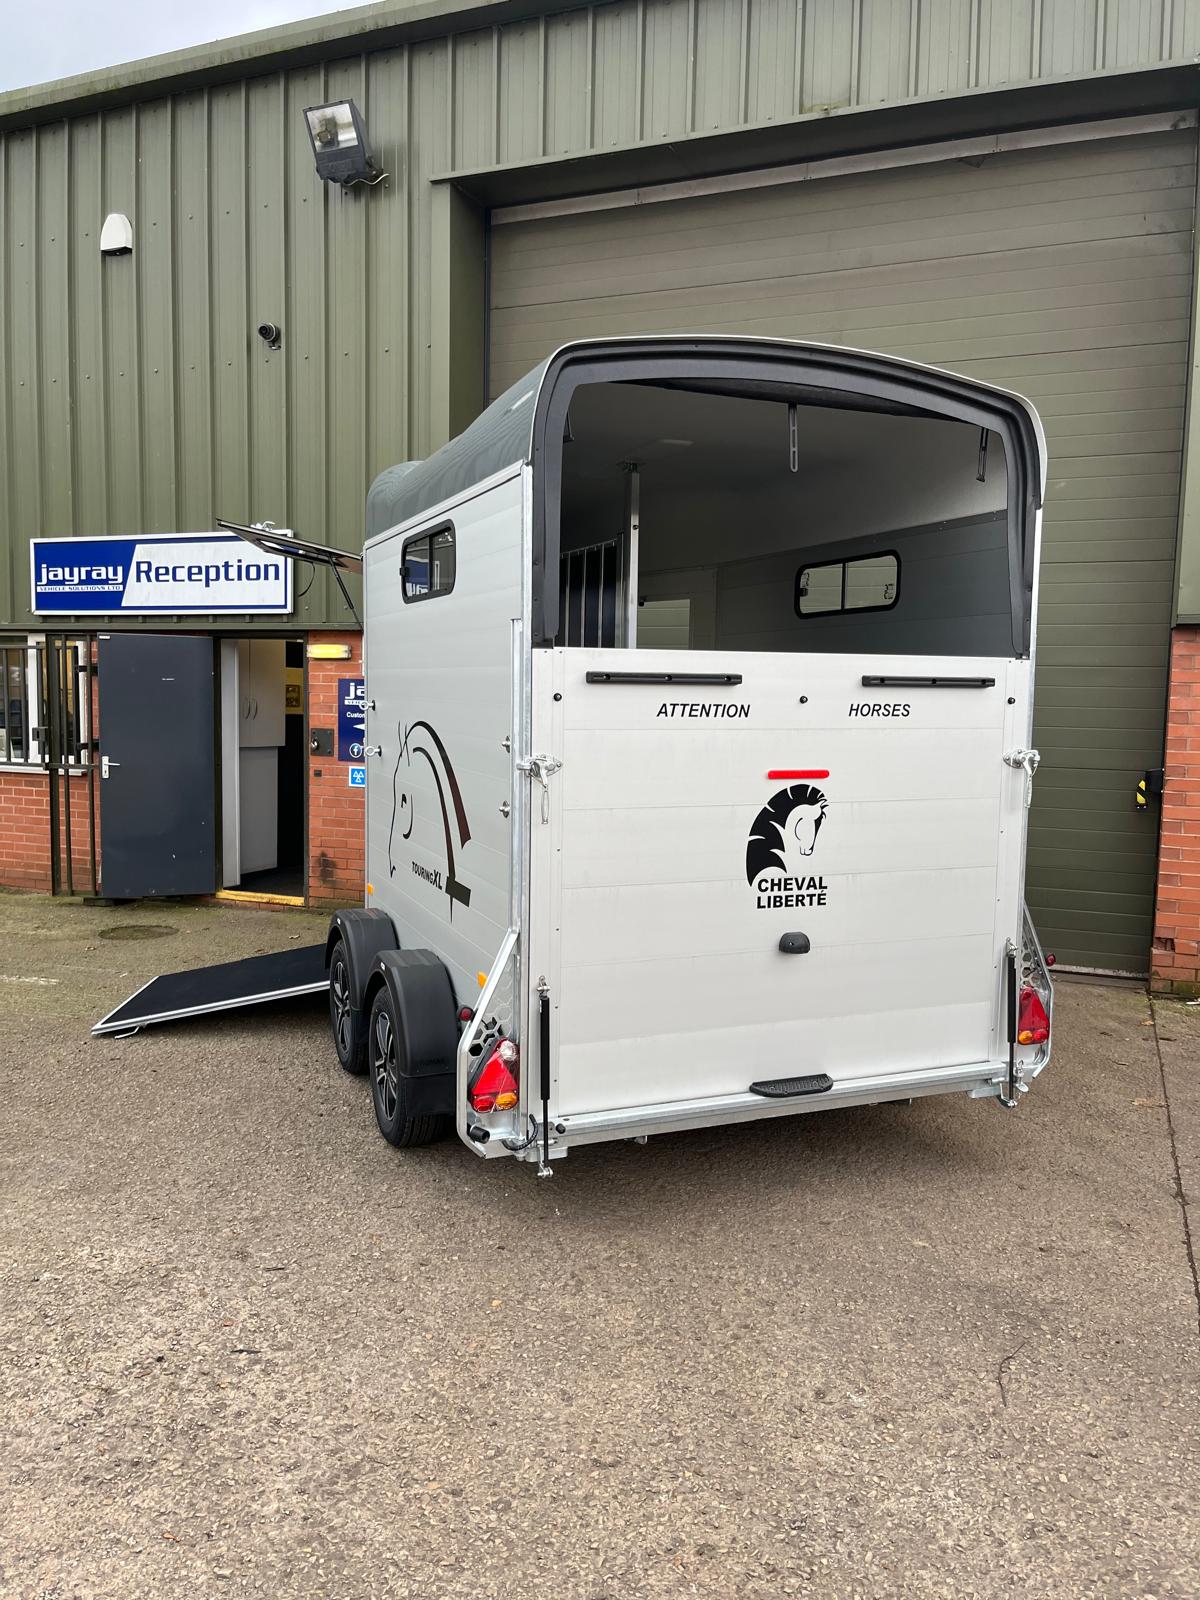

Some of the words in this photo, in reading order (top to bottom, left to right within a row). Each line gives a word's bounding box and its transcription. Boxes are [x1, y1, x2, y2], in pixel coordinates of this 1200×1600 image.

[37, 563, 123, 585] jayray
[135, 558, 280, 588] Reception
[656, 703, 751, 718] ATTENTION
[848, 703, 911, 717] HORSES
[757, 876, 828, 893] CHEVAL
[756, 890, 827, 909] LIBERTÉ
